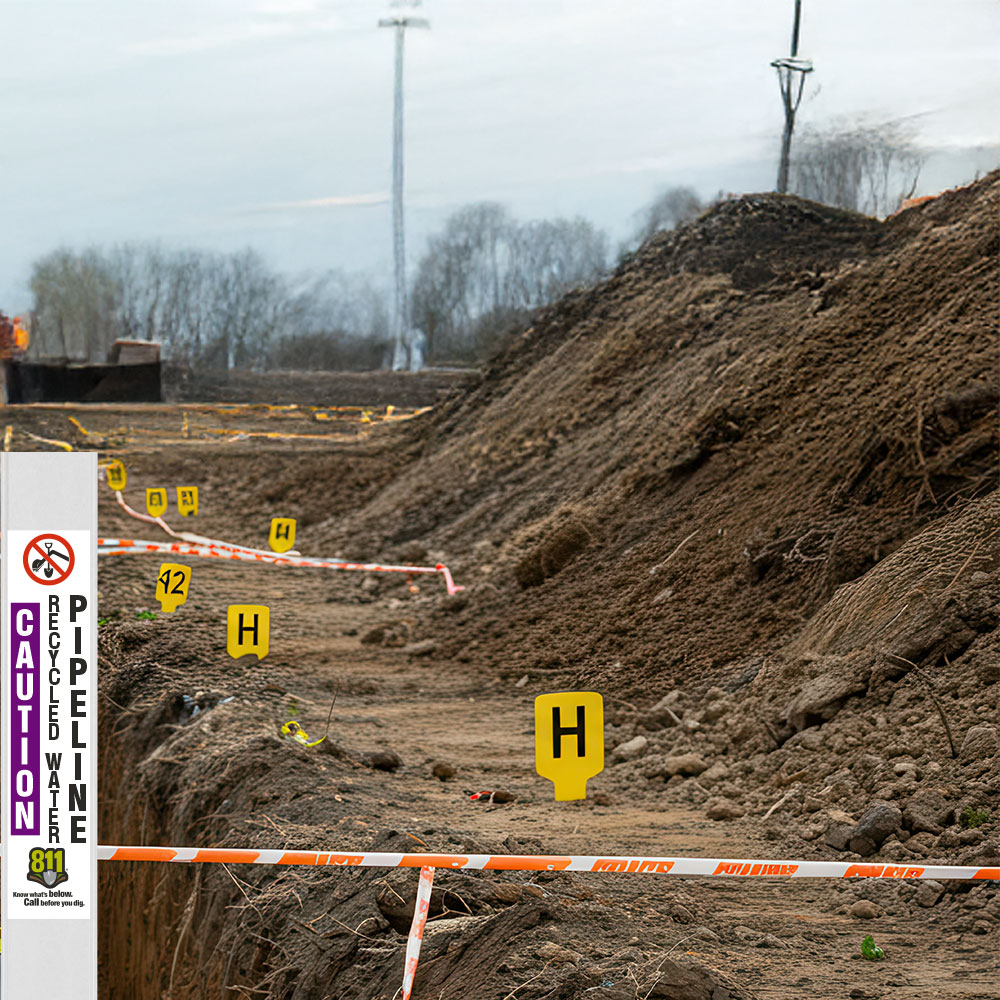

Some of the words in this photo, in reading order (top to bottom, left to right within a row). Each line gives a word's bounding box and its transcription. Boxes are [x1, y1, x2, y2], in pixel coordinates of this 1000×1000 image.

[238, 613, 259, 646] H
[48, 594, 61, 741] RECYCLED
[15, 608, 35, 830] CAUTION
[69, 594, 88, 844] PIPELINE
[551, 705, 586, 759] H
[44, 752, 63, 844] WATER
[30, 848, 64, 873] 811
[23, 898, 40, 907] Call
[40, 899, 61, 907] before
[73, 899, 86, 908] dig.
[48, 889, 73, 898] below.
